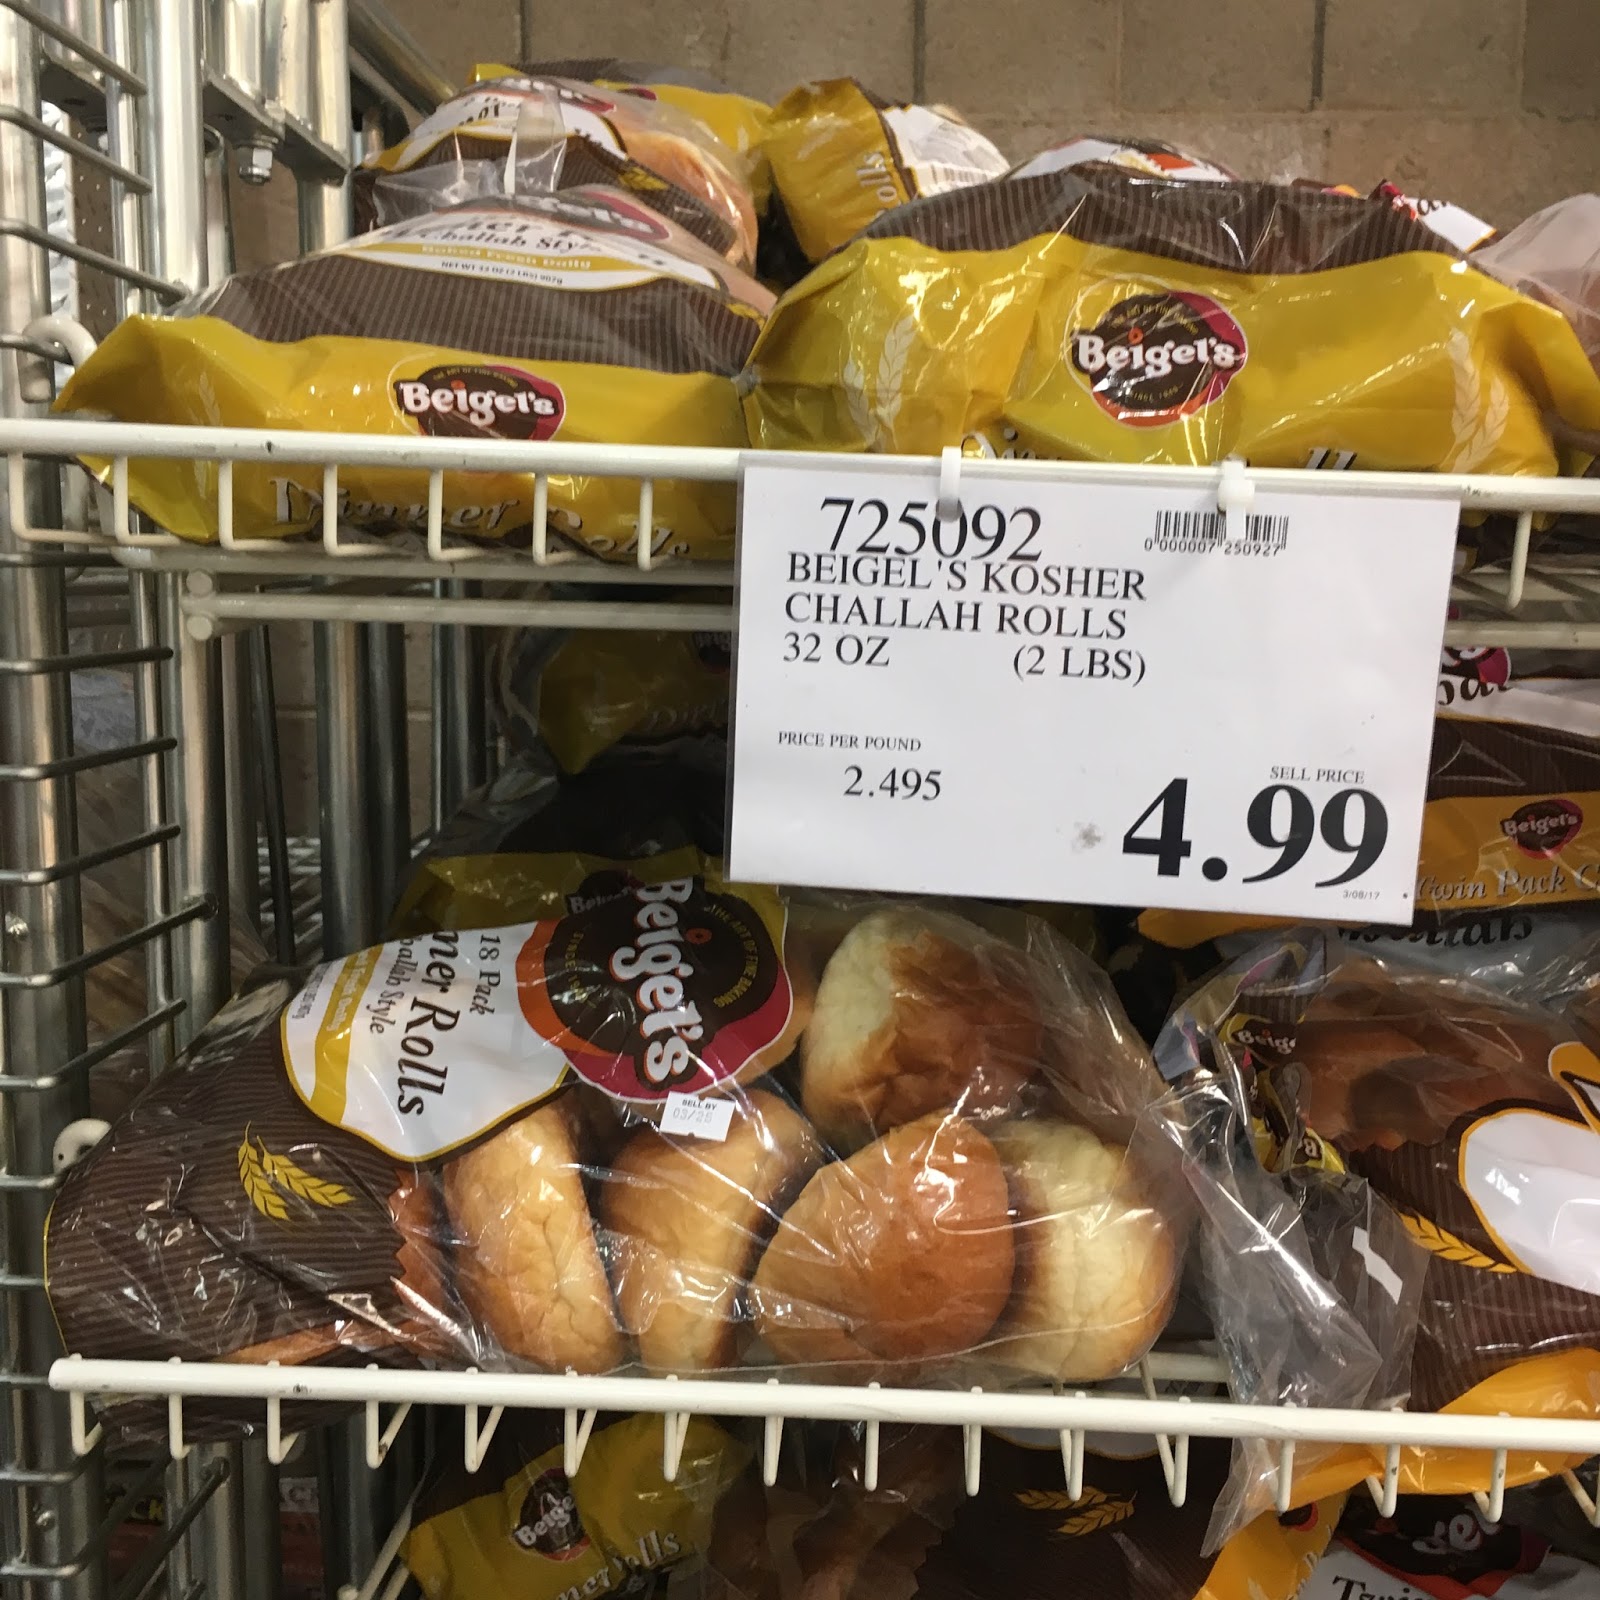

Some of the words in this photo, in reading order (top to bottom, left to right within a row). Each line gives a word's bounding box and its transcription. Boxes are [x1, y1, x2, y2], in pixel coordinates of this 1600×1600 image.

[1076, 333, 1237, 377] Beigel's
[399, 379, 555, 427] Beigel's
[820, 496, 1043, 563] 725092
[786, 552, 967, 592] BEIGEL'S
[981, 561, 1148, 601] KOSHER
[784, 591, 984, 634] CHALLAH
[997, 602, 1128, 641] ROLLS
[783, 631, 822, 663] 32
[835, 634, 891, 667] OZ
[1012, 645, 1046, 681] (2
[1058, 646, 1147, 687] LBS)
[777, 730, 825, 748] PRICE
[829, 734, 859, 749] PER
[864, 735, 922, 752] POUND
[842, 764, 943, 801] 2.495
[1269, 765, 1311, 782] SELL
[1316, 768, 1365, 784] PRICE
[1122, 777, 1389, 889] 4.99
[1503, 813, 1579, 836] Beigel's
[1342, 889, 1381, 900] 3/08/17
[1500, 864, 1567, 897] Pack
[478, 933, 501, 962] 18
[730, 918, 751, 941] ART
[365, 988, 405, 1035] Style
[469, 969, 502, 1015] Pack
[396, 996, 461, 1117] Rolls
[704, 1103, 718, 1111] BY
